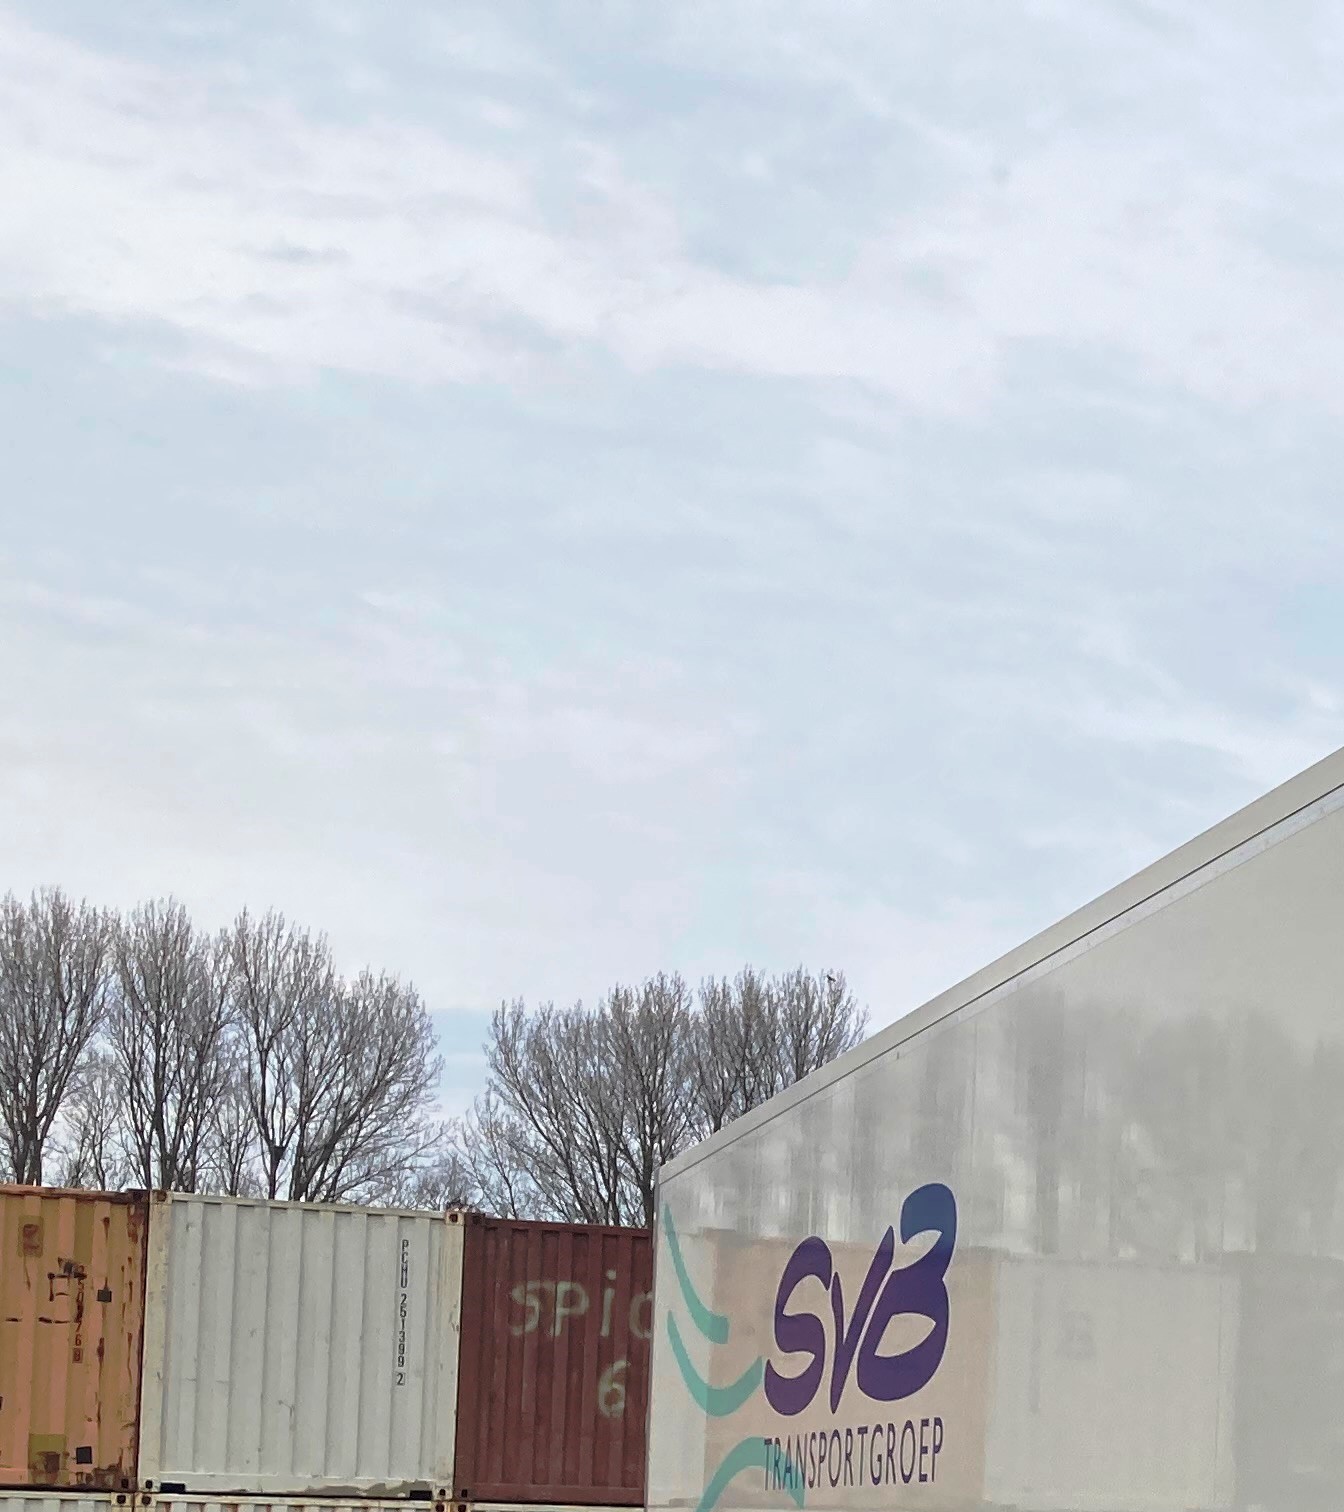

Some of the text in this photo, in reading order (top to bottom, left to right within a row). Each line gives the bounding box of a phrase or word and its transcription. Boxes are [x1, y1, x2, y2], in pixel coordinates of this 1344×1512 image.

[401, 1239, 410, 1288] PCHU
[763, 1183, 958, 1416] SVB
[597, 1360, 630, 1419] 6
[764, 1417, 944, 1491] TRANSPORTGROEP
